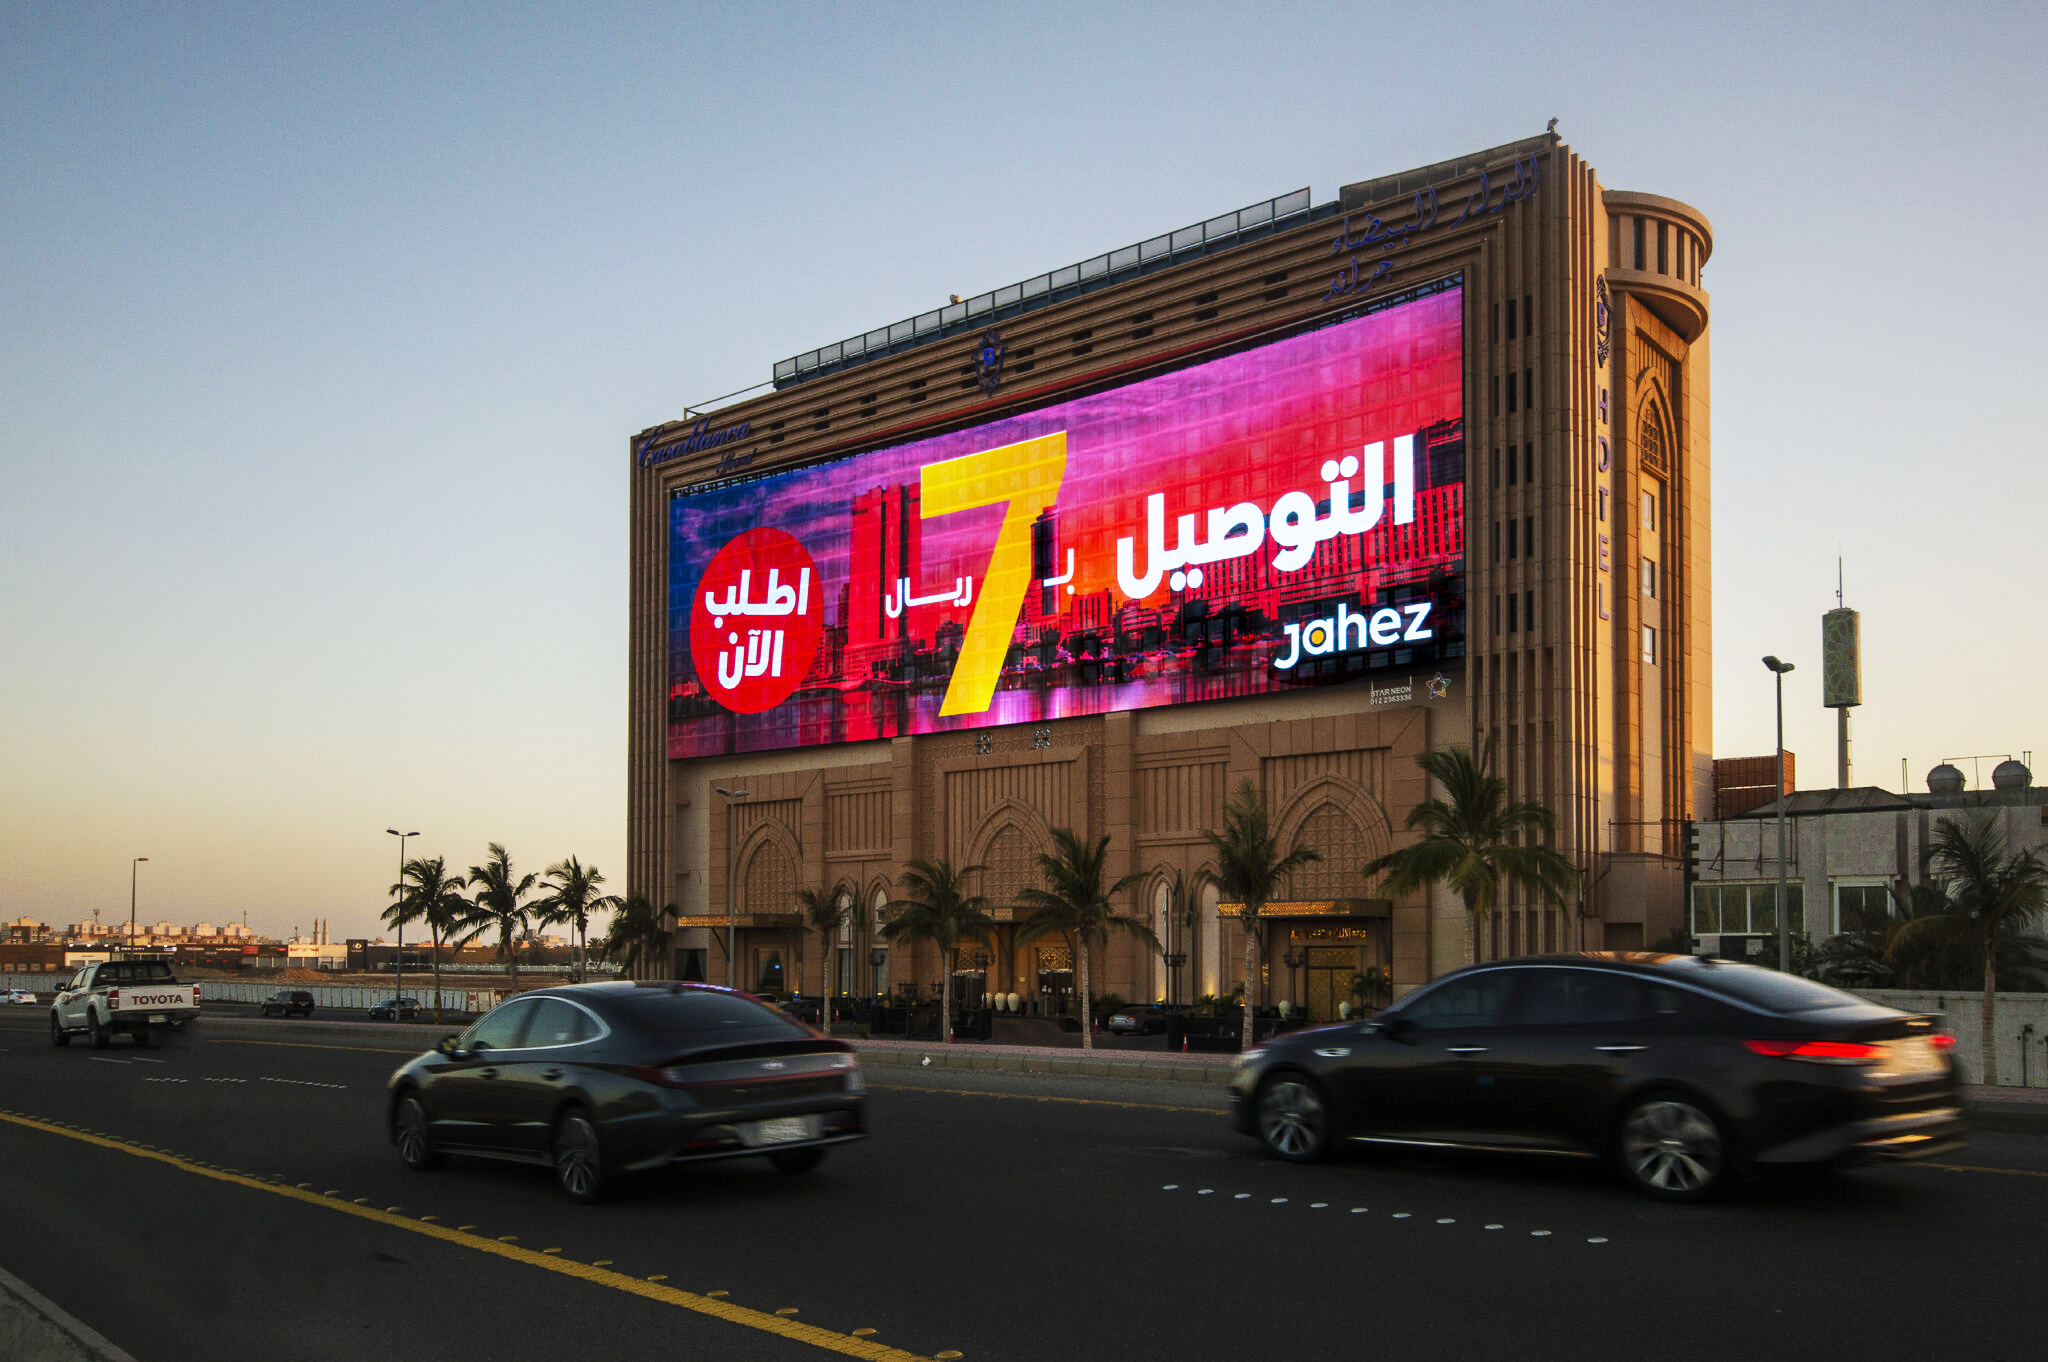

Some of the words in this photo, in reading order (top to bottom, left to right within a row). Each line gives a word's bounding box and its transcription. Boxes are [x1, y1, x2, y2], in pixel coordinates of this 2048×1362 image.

[1329, 185, 1440, 255] البيضاء
[1448, 153, 1540, 229] الدار
[1320, 255, 1393, 302] جراند
[635, 415, 750, 471] Casablanca
[1116, 433, 1415, 600] التوصيل
[1597, 383, 1610, 622] HOTEL
[705, 566, 811, 629] اطلب
[884, 575, 974, 619] ريال
[920, 430, 1068, 718] 7
[717, 628, 785, 690] الآن
[1273, 601, 1433, 670] jahez
[1391, 686, 1411, 694] NEON
[131, 994, 184, 1006] TOYOTA
